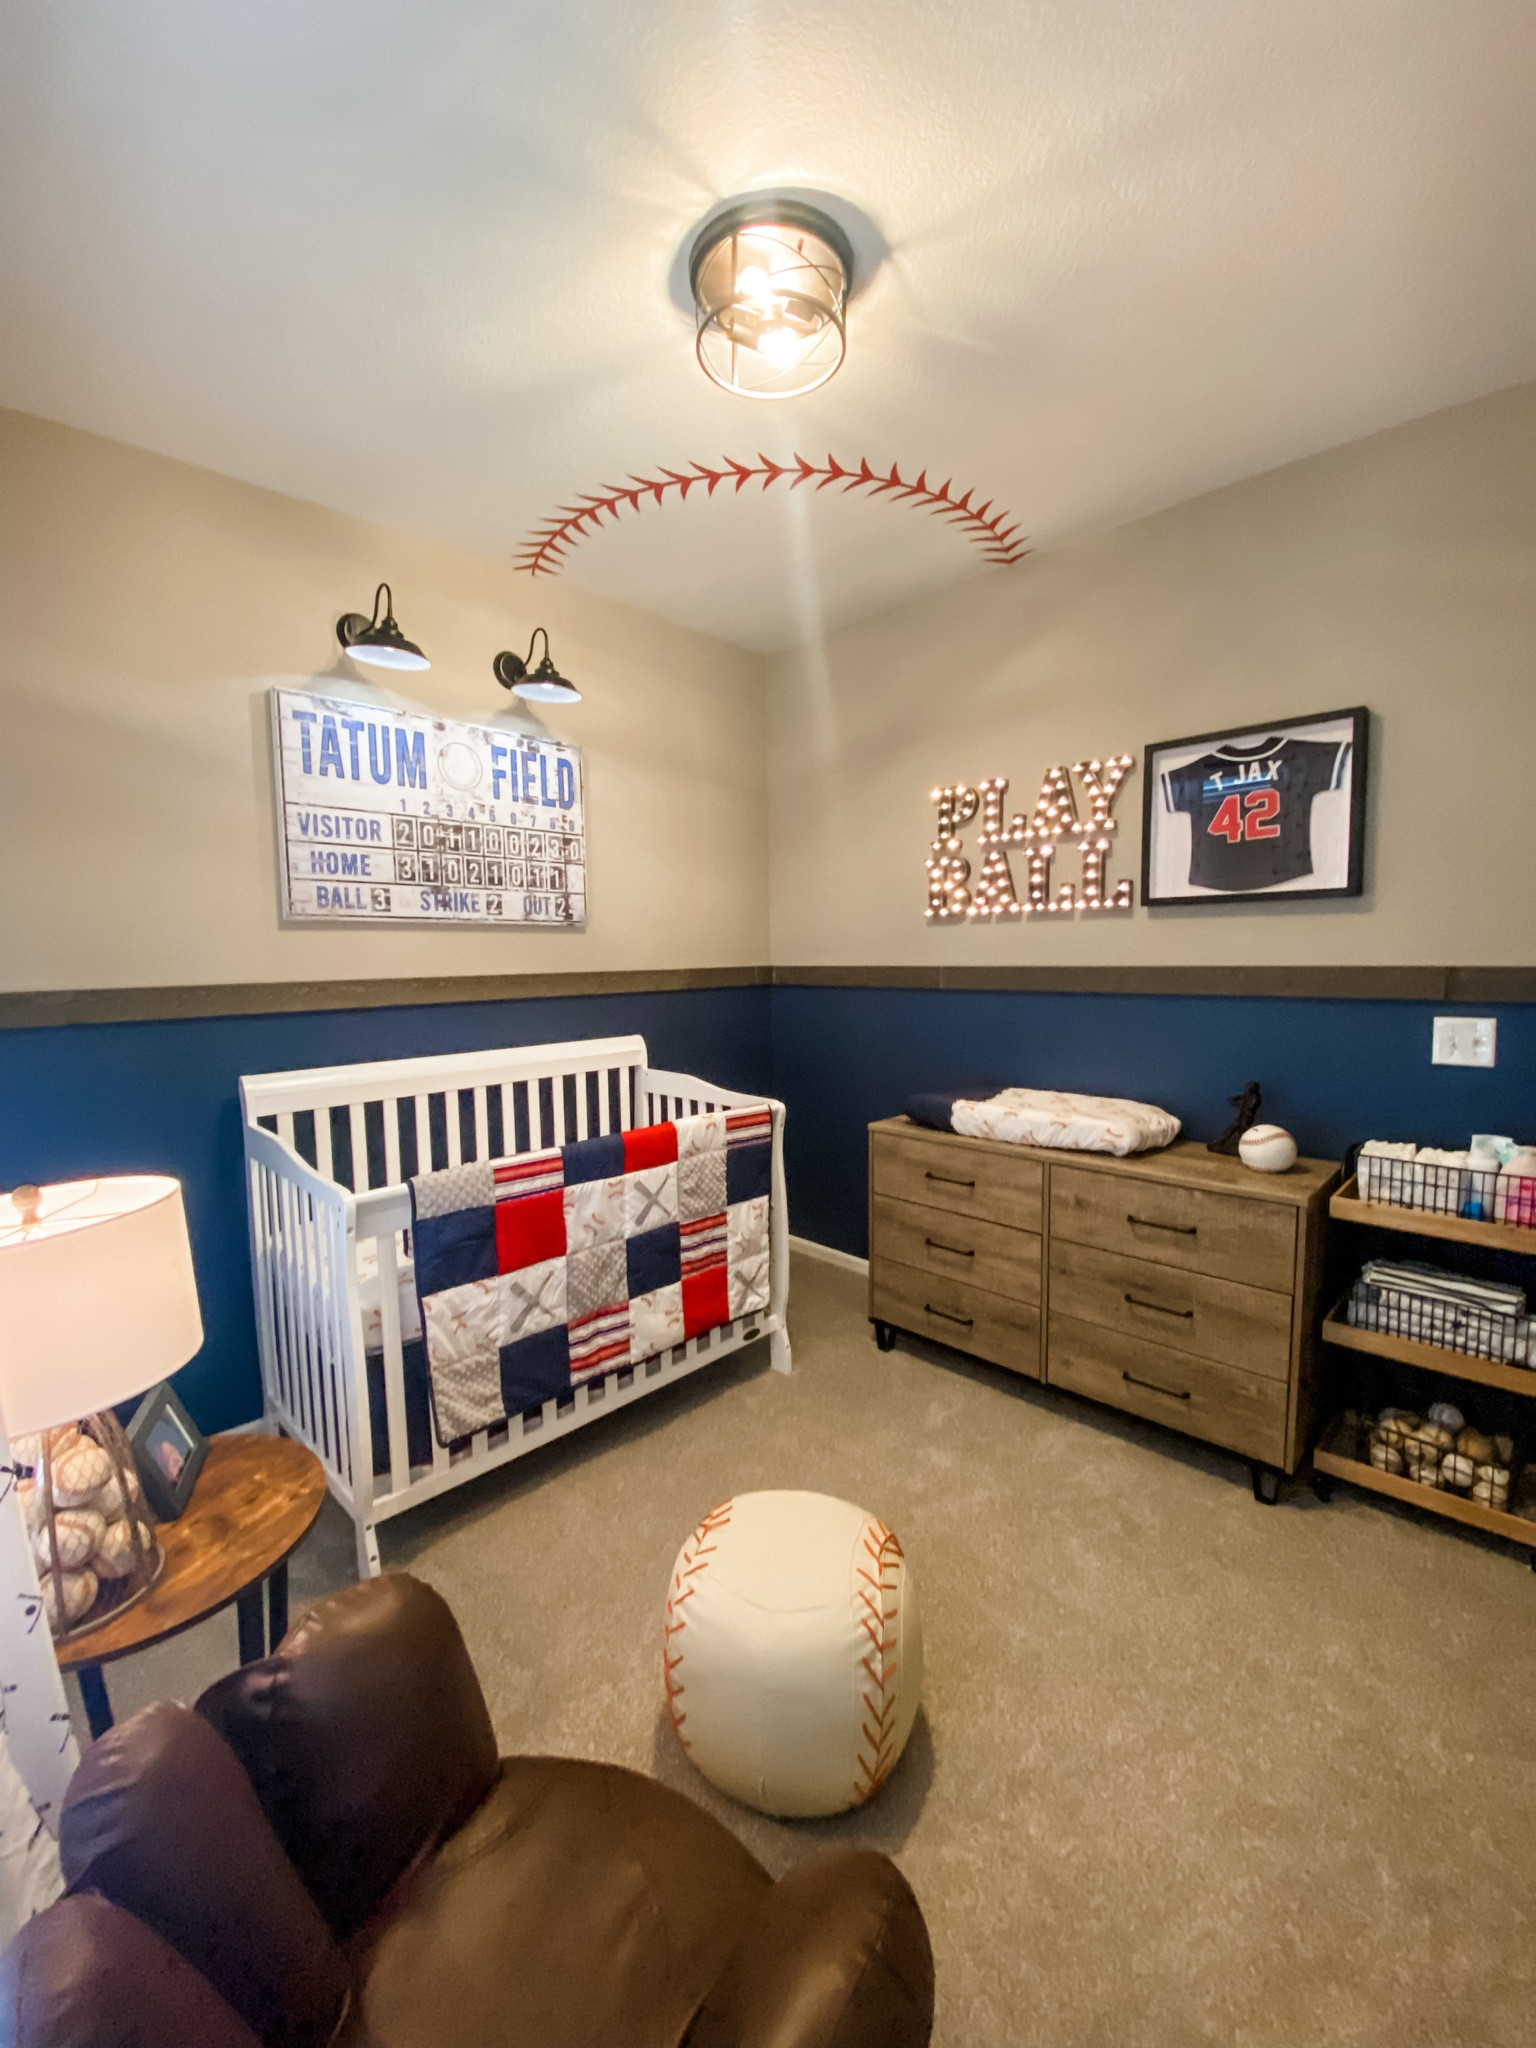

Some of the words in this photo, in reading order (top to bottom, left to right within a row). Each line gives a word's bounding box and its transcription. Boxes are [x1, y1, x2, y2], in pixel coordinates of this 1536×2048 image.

[292, 710, 428, 790] TATUM
[491, 745, 575, 810] FIELD
[1209, 770, 1223, 791] T
[1233, 760, 1283, 785] JAX
[400, 799, 406, 812] 1
[423, 801, 430, 815] 2
[446, 804, 453, 817] 3
[468, 807, 475, 820] 4
[489, 809, 496, 822] 5
[530, 815, 537, 827] 7
[930, 755, 1136, 850] PLAY
[1207, 788, 1281, 844] 42
[297, 812, 382, 841] VISITOR
[398, 822, 410, 844] 2
[423, 825, 434, 846] 0
[468, 830, 477, 851] 1
[489, 831, 499, 851] 0
[510, 834, 520, 854] 0
[530, 837, 540, 856] 2
[550, 839, 559, 858] 3
[570, 841, 579, 860] 0
[310, 850, 372, 877] HOME
[401, 856, 412, 879] 3
[425, 857, 435, 880] 1
[447, 860, 458, 882] 0
[469, 863, 480, 883] 2
[490, 864, 499, 885] 1
[511, 866, 521, 886] 0
[532, 868, 541, 887] 1
[553, 869, 561, 888] 1
[924, 837, 1135, 918] BALL
[316, 885, 368, 910] BALL
[374, 888, 386, 911] 3
[420, 890, 481, 914] STRIKE
[488, 895, 499, 915] 2
[523, 895, 551, 916] OUT
[557, 898, 567, 917] 2
